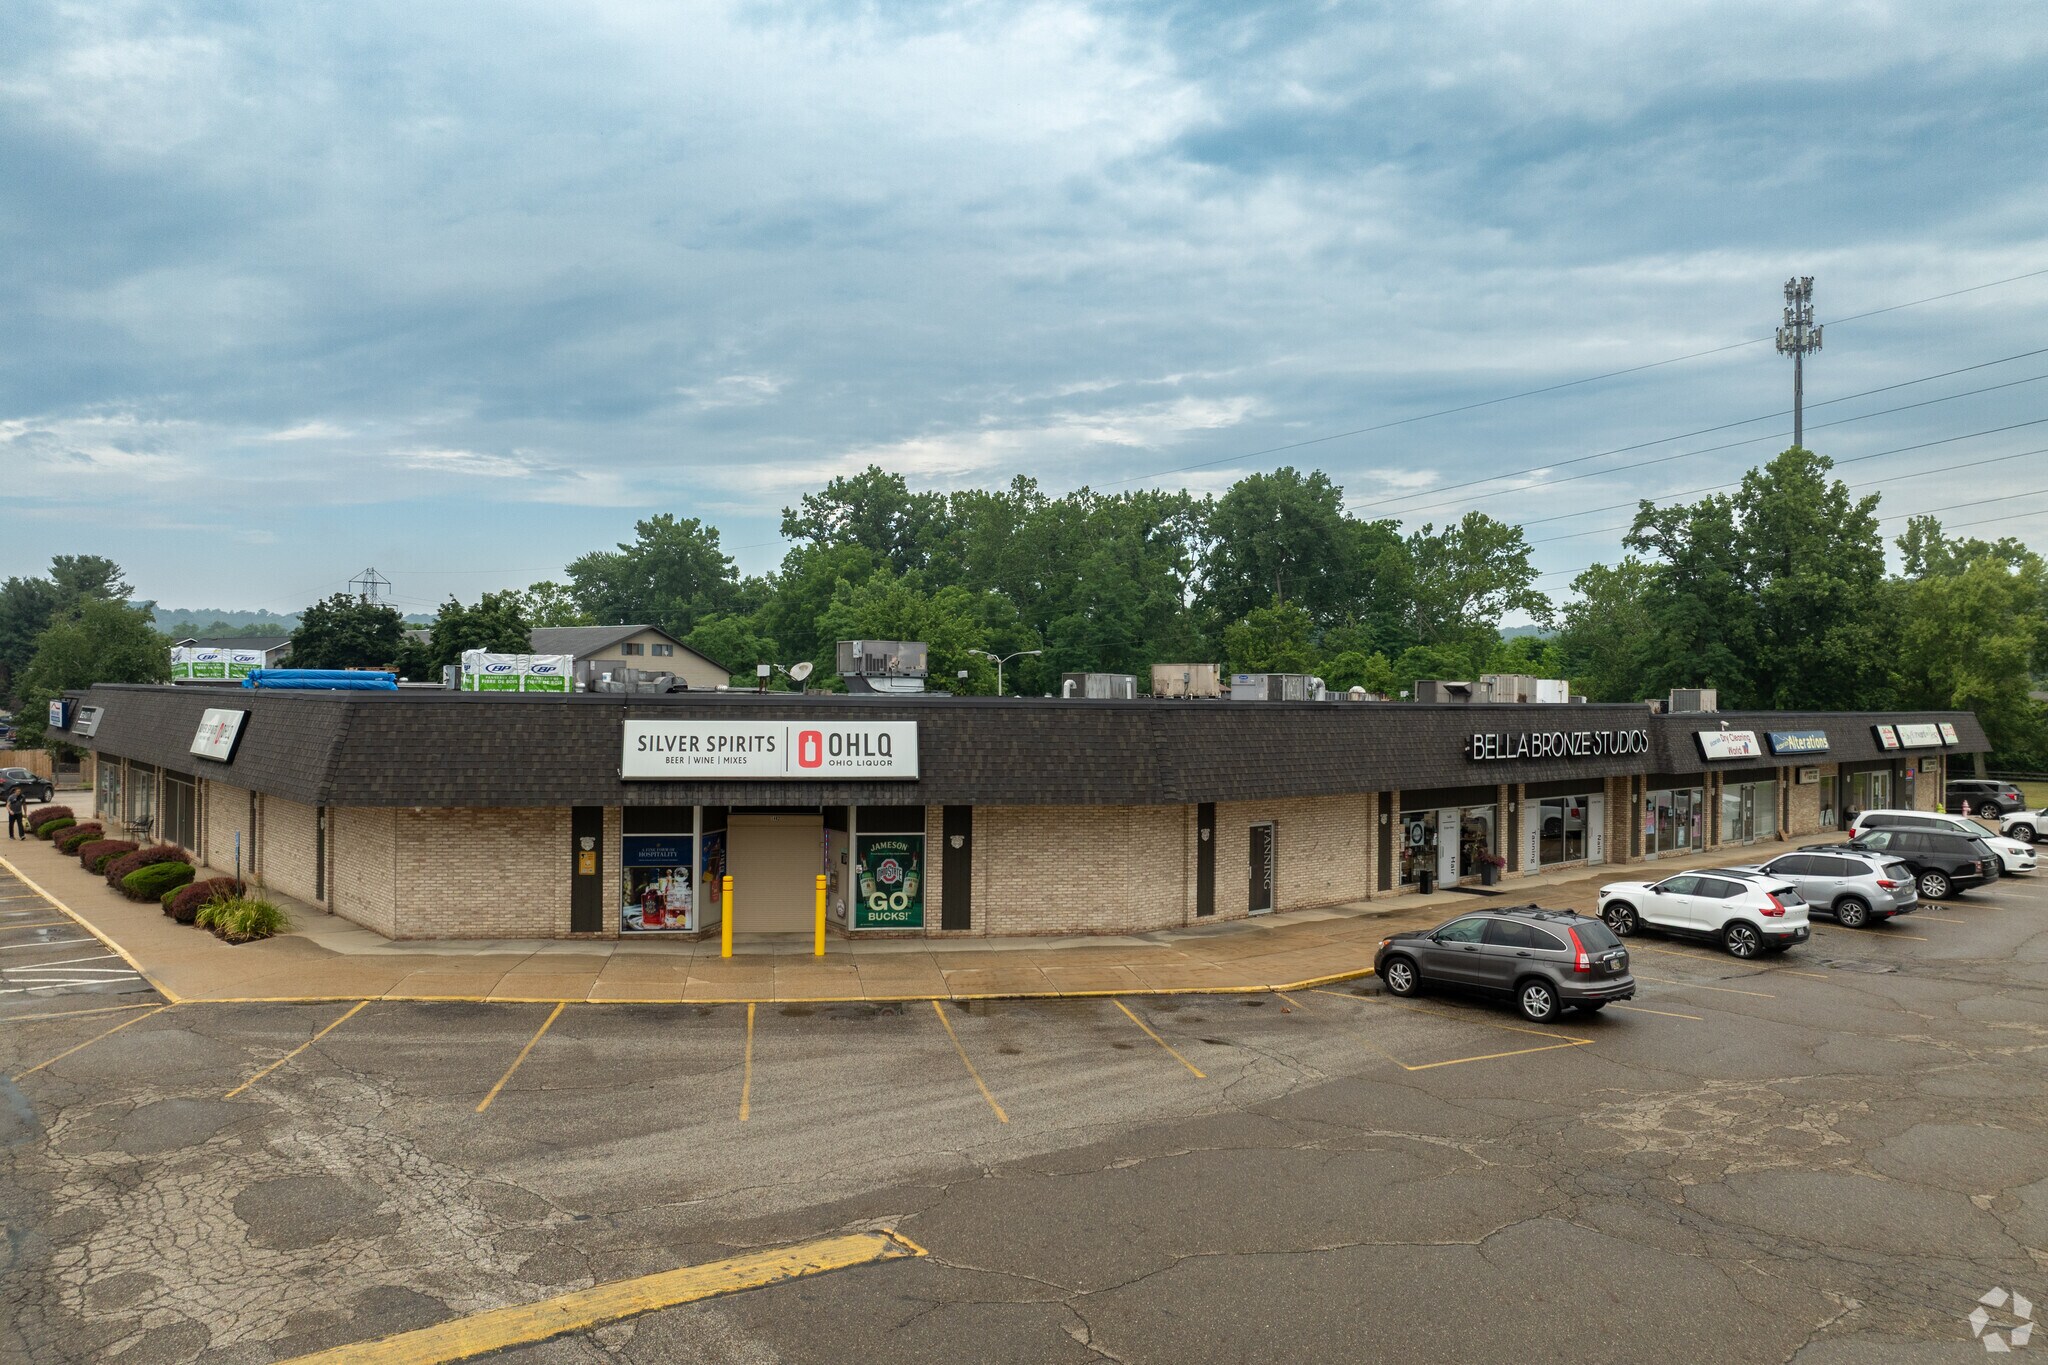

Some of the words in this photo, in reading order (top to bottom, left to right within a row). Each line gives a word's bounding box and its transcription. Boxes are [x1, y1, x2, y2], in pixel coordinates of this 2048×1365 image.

[637, 735, 700, 752] SILVER
[706, 735, 776, 752] SPIRITS
[828, 732, 893, 758] OHLQ
[1473, 732, 1530, 760] BELLA
[1531, 731, 1591, 758] BRONZE
[1592, 729, 1649, 755] STUDIOS
[1719, 733, 1729, 744] Dry
[1788, 734, 1828, 750] Alterations
[665, 756, 685, 764] BEER
[693, 756, 715, 764] WINE
[723, 756, 748, 764] MIXES
[828, 759, 853, 767] OHIO
[856, 759, 893, 767] LIQUOR
[870, 841, 908, 852] JAMESON
[1263, 826, 1272, 890] TANNING
[869, 891, 908, 911] GO
[868, 912, 908, 921] BUCKS!
